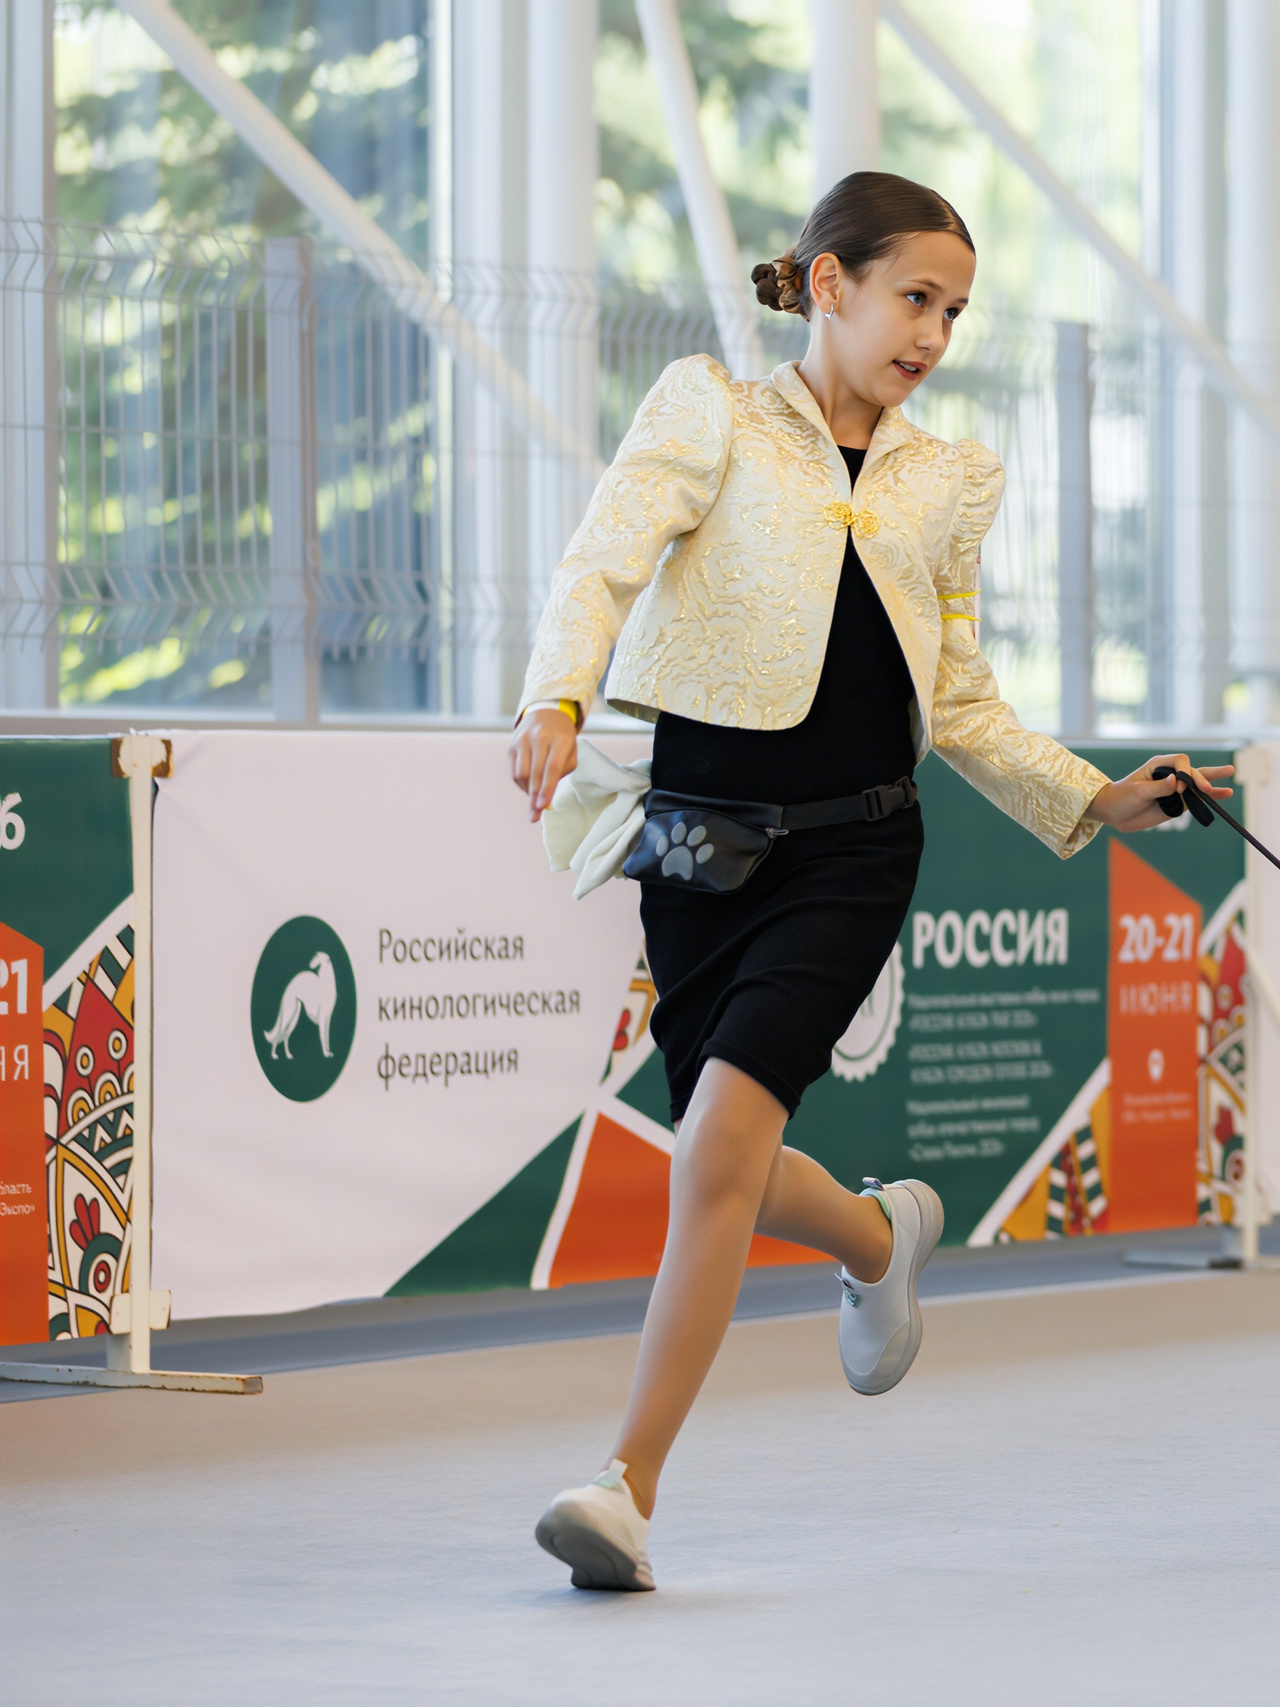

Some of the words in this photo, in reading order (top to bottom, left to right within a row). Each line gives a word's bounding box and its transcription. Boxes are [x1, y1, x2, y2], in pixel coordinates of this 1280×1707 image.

[378, 926, 525, 964] Российская
[912, 908, 1069, 969] РОССИЯ
[1117, 912, 1195, 964] 20-21
[377, 989, 582, 1021] кинологическая
[376, 1042, 519, 1092] федерация
